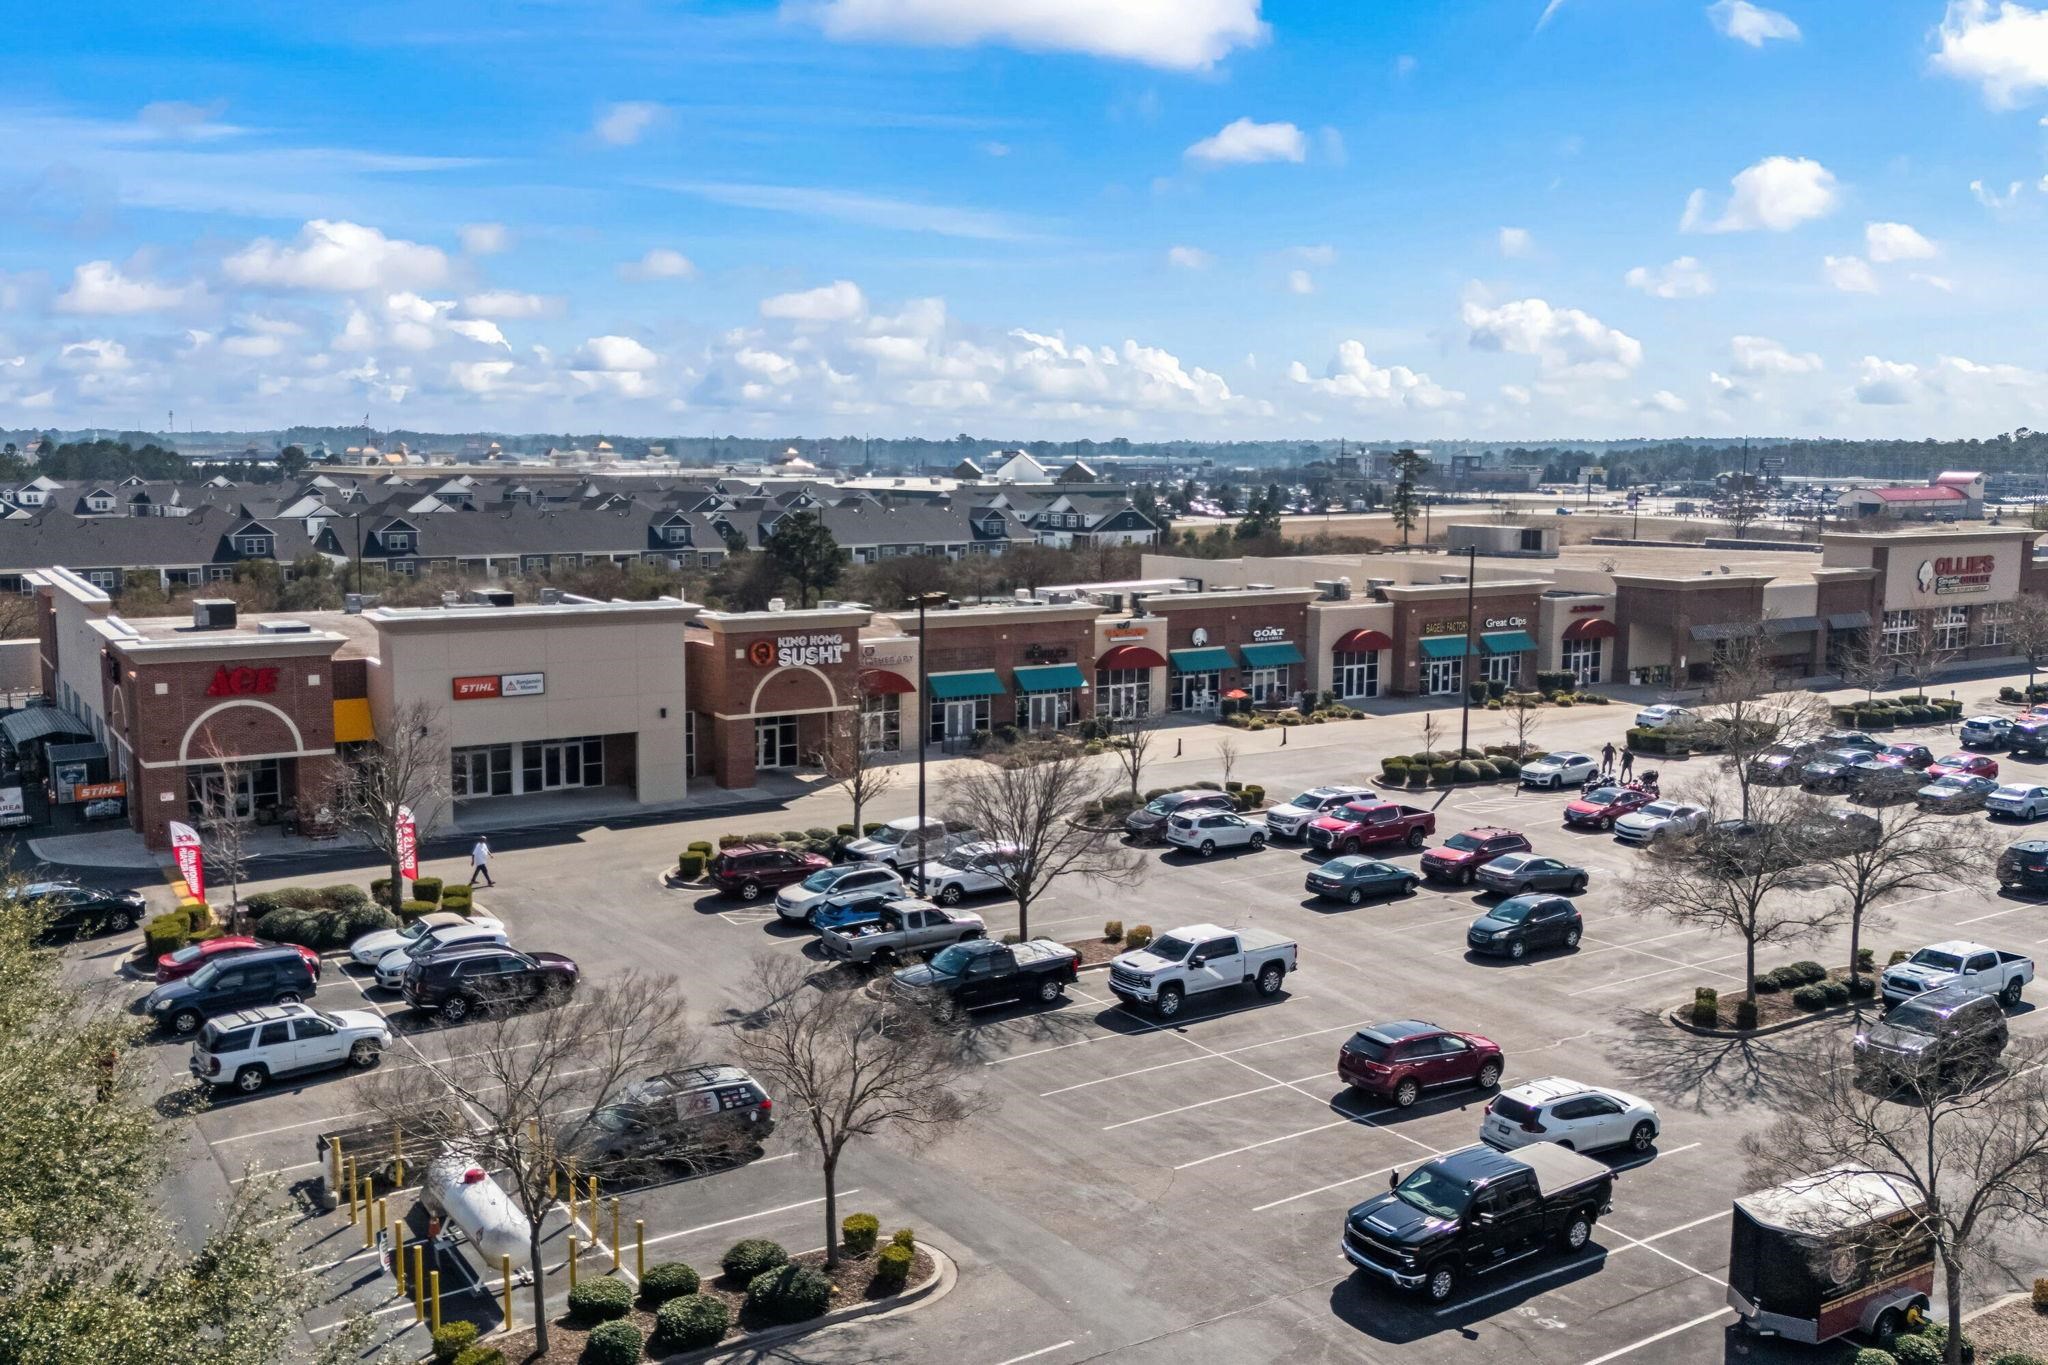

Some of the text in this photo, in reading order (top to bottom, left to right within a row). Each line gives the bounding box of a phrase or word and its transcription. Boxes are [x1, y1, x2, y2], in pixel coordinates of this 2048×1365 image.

[1486, 617, 1527, 628] Great Clips
[1253, 628, 1285, 637] GOAT
[778, 634, 842, 647] KING KONG
[778, 645, 842, 666] SUSHI
[206, 664, 282, 697] ACE
[460, 683, 495, 693] STIHL
[81, 785, 121, 797] STIHL
